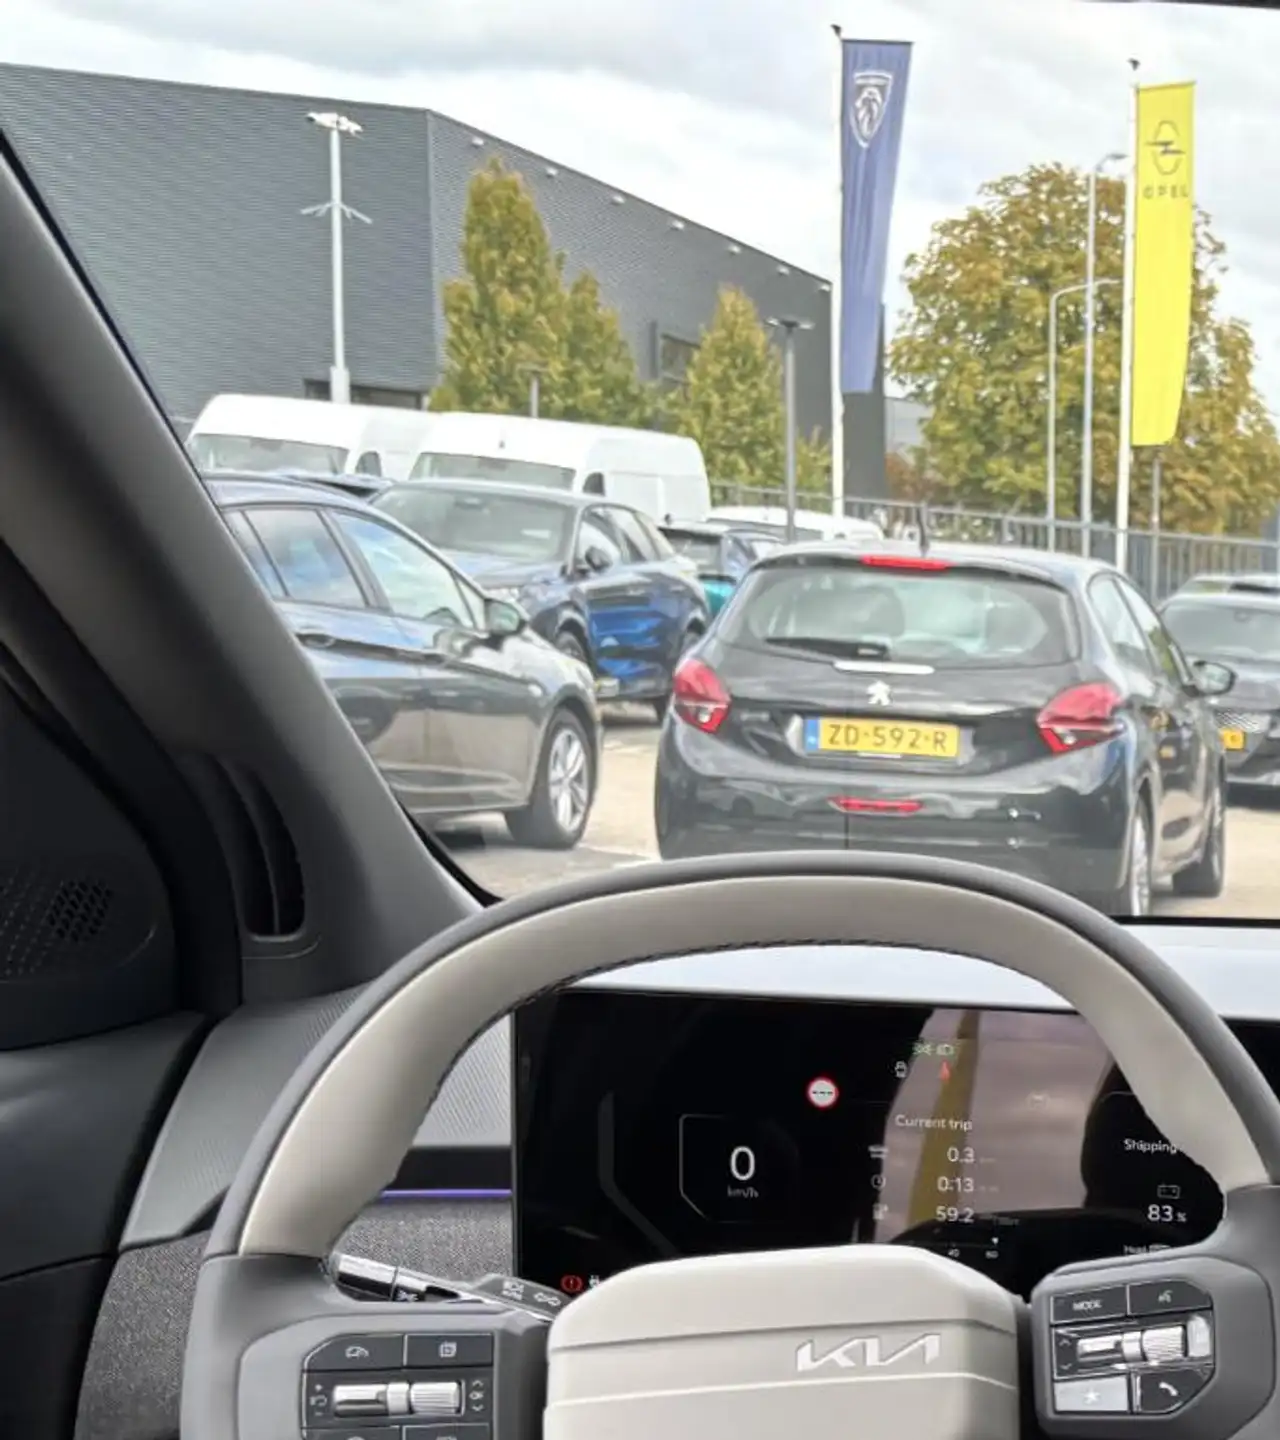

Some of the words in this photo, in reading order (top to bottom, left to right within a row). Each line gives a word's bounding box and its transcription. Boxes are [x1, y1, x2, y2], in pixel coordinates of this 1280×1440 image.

[895, 1114, 946, 1129] Current
[949, 1118, 972, 1132] trip
[946, 1146, 975, 1163] 0.3
[1124, 1138, 1177, 1155] Shipping
[730, 1146, 756, 1181] 0
[936, 1205, 975, 1223] 59.2
[1147, 1204, 1173, 1222] 83
